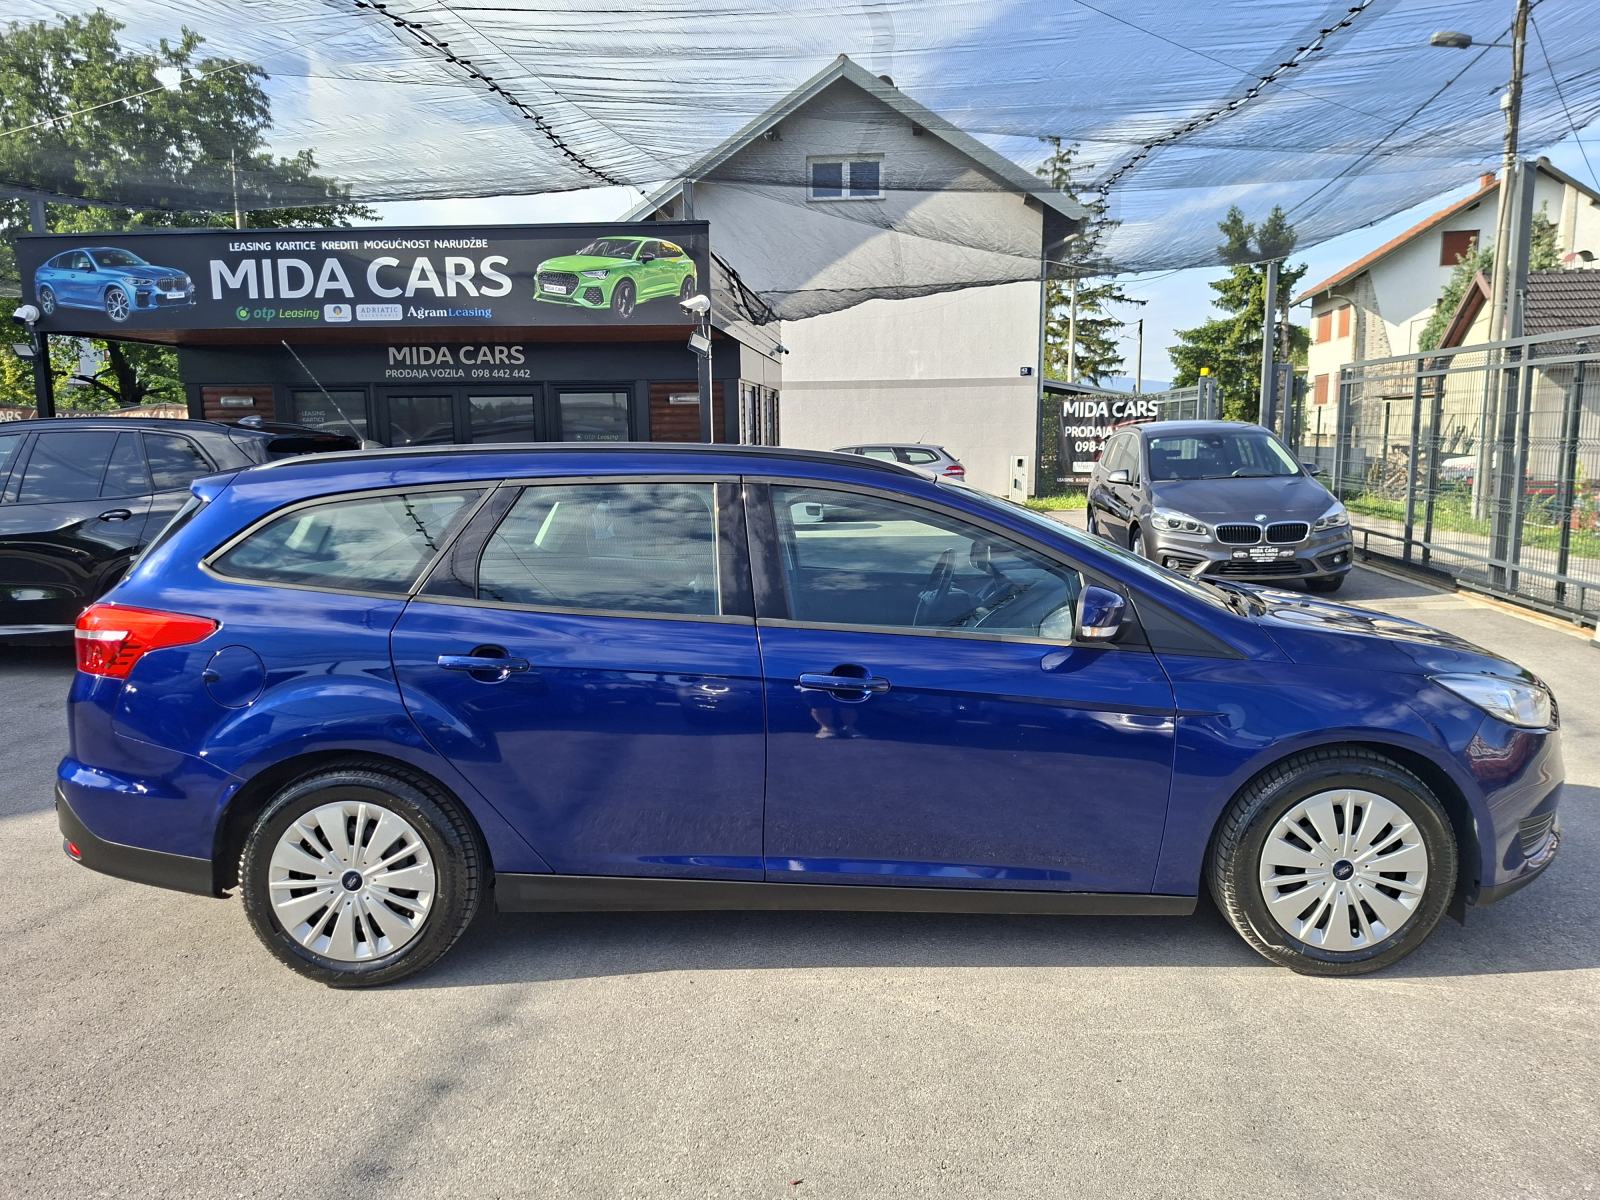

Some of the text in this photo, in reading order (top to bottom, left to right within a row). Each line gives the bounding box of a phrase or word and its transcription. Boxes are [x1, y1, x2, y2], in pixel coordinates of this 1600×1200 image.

[229, 242, 271, 251] LEASING
[276, 241, 316, 250] KARTICE
[322, 240, 358, 250] KREDITI
[434, 237, 488, 248] NARUDŽBE
[209, 255, 513, 299] MIDA CARS
[253, 307, 320, 321] otp Leasing
[360, 306, 399, 314] ADRIATIC
[388, 346, 525, 365] MIDA CARS
[385, 369, 531, 379] PRODAJA VOZILA 098 442 442
[1063, 400, 1159, 418] MIDA CARS
[1065, 425, 1114, 439] PRODAJA
